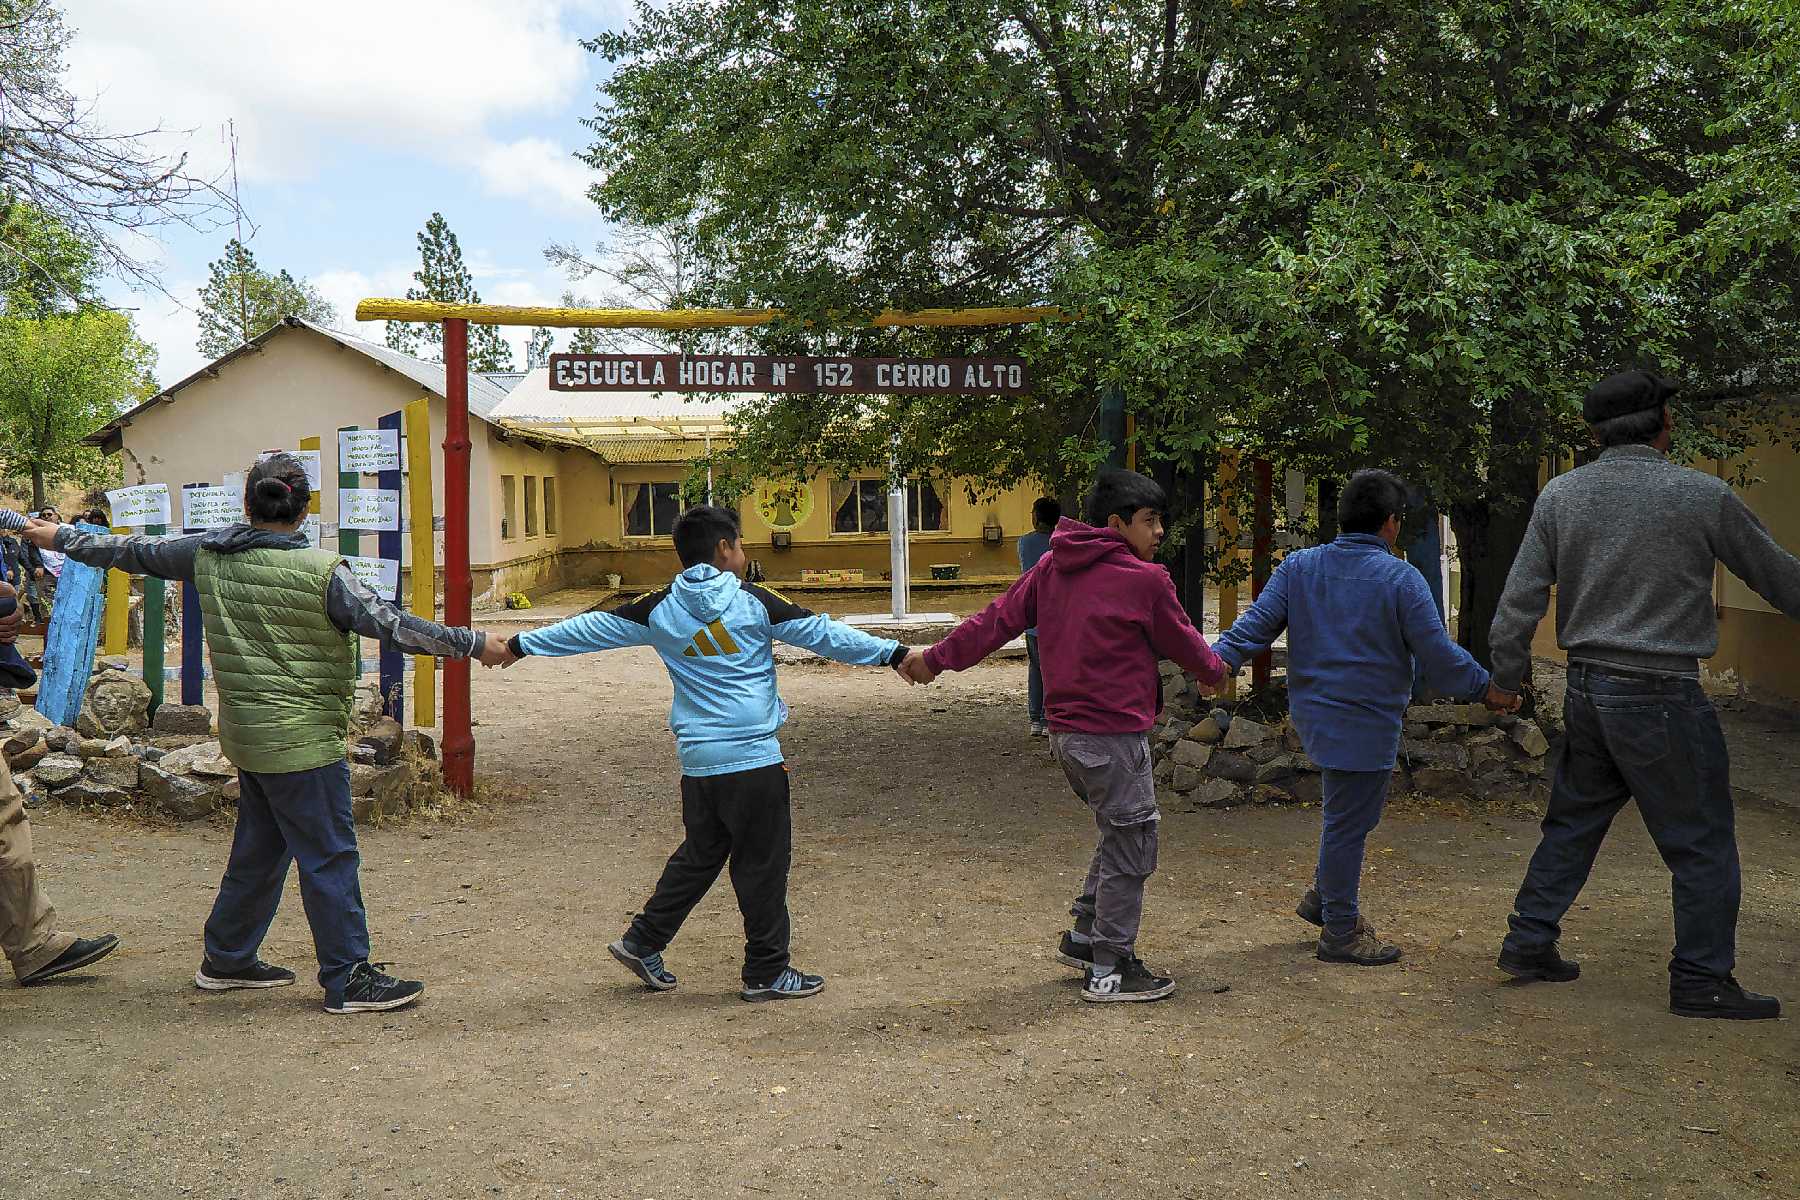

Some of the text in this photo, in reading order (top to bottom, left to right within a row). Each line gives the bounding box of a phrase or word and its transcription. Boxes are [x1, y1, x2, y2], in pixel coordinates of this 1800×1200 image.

[556, 360, 666, 386] ESCUELA
[679, 361, 756, 386] HOGAR
[813, 363, 854, 387] 152
[877, 363, 951, 388] CERRO
[964, 364, 1022, 389] ALTO
